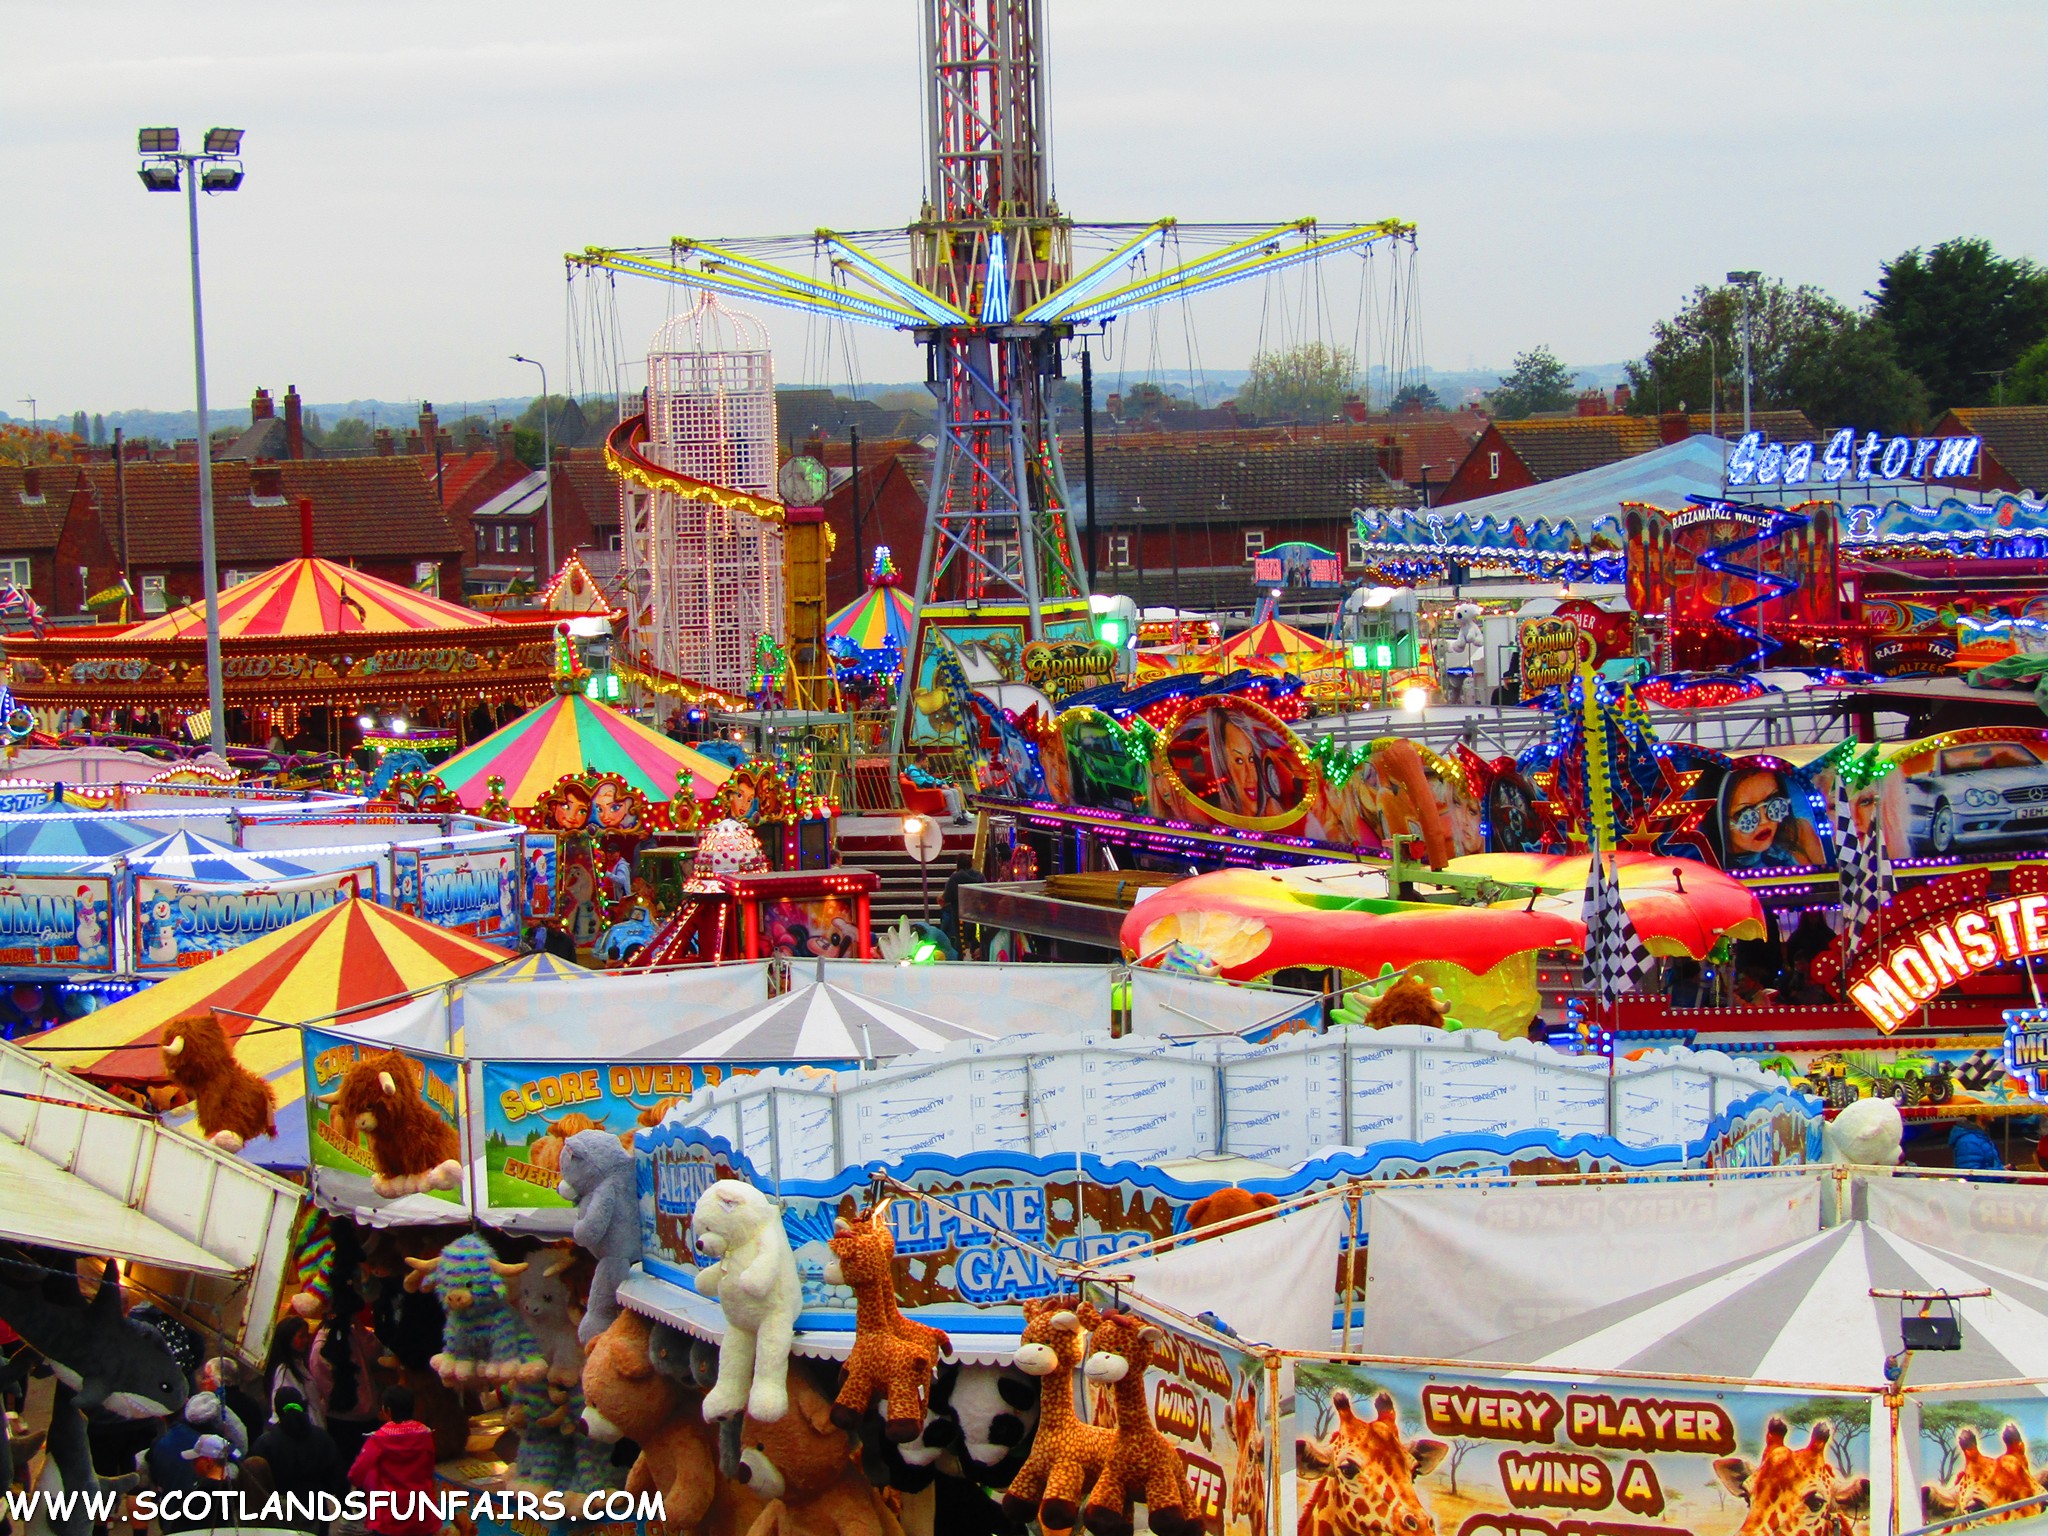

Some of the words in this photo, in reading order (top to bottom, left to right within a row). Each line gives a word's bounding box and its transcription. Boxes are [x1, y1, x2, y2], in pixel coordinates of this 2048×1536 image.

[1525, 632, 1574, 658] AROUND
[1029, 656, 1108, 682] AROUND
[1886, 661, 1947, 677] WALTZER
[173, 883, 191, 894] The
[178, 887, 336, 933] SNOWMAN
[424, 866, 500, 915] SNOWMAN
[1848, 893, 2048, 1035] MONSTE
[500, 1068, 602, 1123] SCORE
[609, 1064, 695, 1097] OVER
[703, 1064, 722, 1087] 3
[503, 1158, 563, 1190] EVERY
[659, 1162, 716, 1204] ALPINE
[892, 1187, 1043, 1248] LPINE
[1178, 1341, 1231, 1388] PLAYER
[1156, 1386, 1196, 1428] WINS
[1201, 1406, 1210, 1436] A
[1428, 1392, 1553, 1433] EVERY
[1572, 1401, 1725, 1443] PLAYER
[1505, 1457, 1604, 1497] WINS
[1624, 1466, 1653, 1500] A
